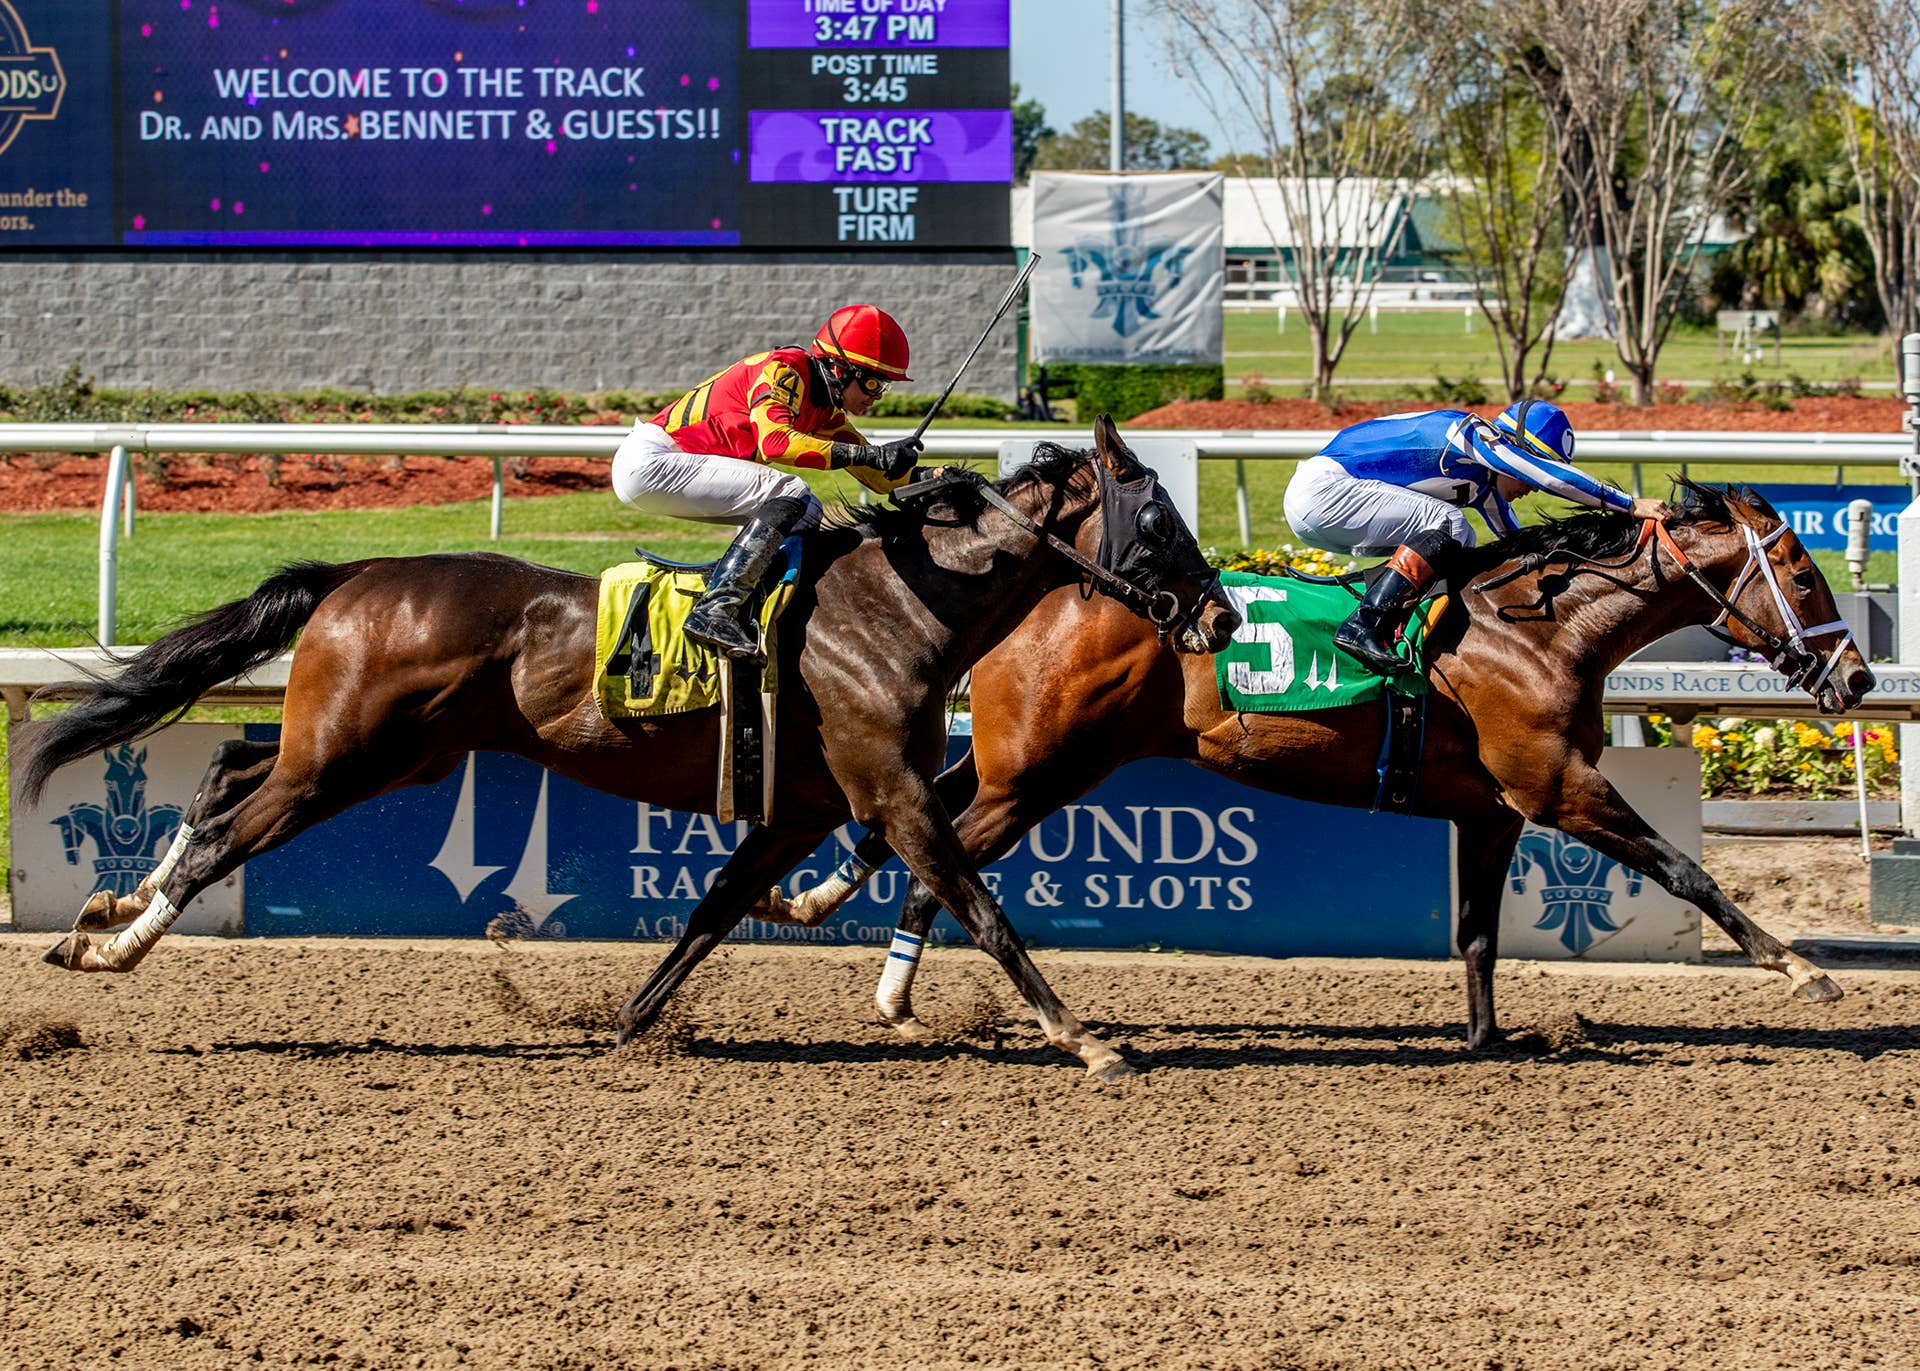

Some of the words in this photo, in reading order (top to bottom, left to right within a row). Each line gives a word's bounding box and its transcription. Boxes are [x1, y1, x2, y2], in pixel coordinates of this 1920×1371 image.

[805, 0, 856, 13] TIME
[861, 0, 893, 13] OF
[901, 0, 946, 12] DAY
[815, 15, 878, 41] 3:47
[887, 15, 935, 40] PM
[811, 54, 876, 75] POST
[880, 54, 938, 75] TIME
[213, 68, 391, 98] WELCOME
[400, 68, 449, 98] TO
[456, 67, 524, 97] THE
[532, 67, 644, 97] TRACK
[843, 77, 907, 102] 3:45
[359, 110, 517, 140] BENNETT
[525, 109, 553, 140] &
[563, 108, 720, 140] GUESTS!!
[819, 118, 932, 144] TRACK
[836, 146, 917, 172] FAST
[56, 188, 88, 207] the
[832, 187, 919, 213] TURF
[838, 214, 915, 241] FIRM
[777, 372, 800, 407] 4
[604, 582, 661, 700] 4
[1223, 586, 1296, 695] 5
[1024, 870, 1064, 907] &
[1084, 874, 1254, 911] SLOTS
[633, 916, 650, 937] A
[761, 921, 836, 941] Downs
